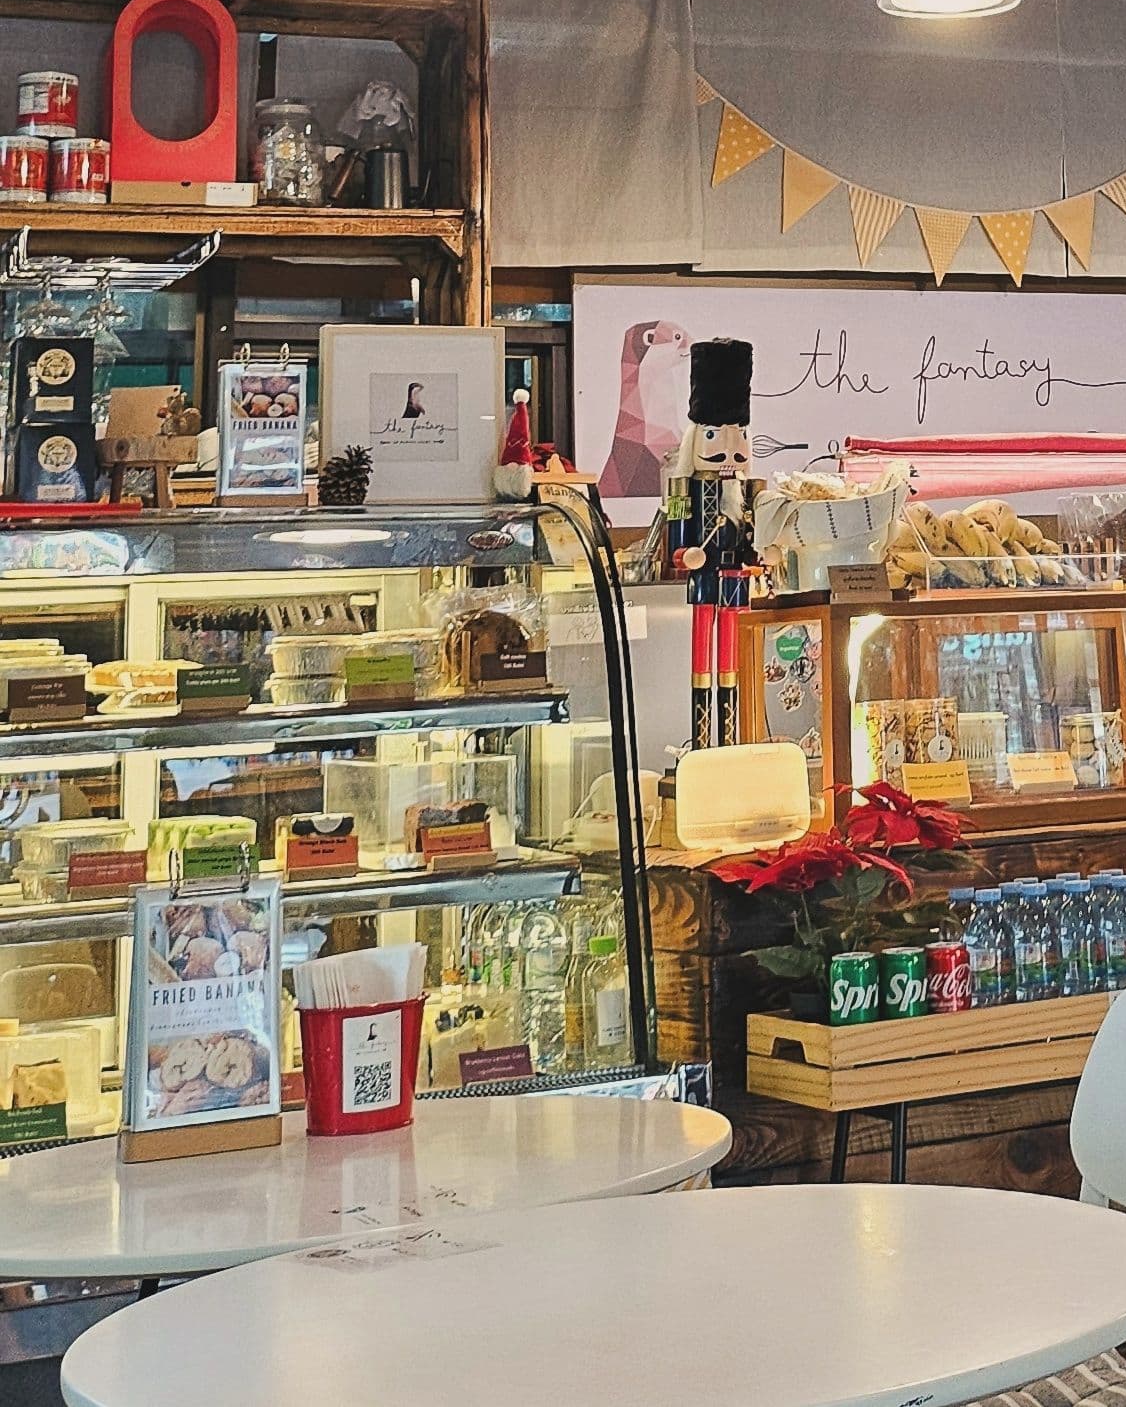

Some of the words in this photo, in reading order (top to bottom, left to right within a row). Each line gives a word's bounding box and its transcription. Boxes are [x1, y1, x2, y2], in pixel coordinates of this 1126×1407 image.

[770, 329, 888, 397] the
[913, 336, 1120, 424] fantasy
[152, 987, 197, 1006] FRIED
[205, 980, 266, 1002] BANANA
